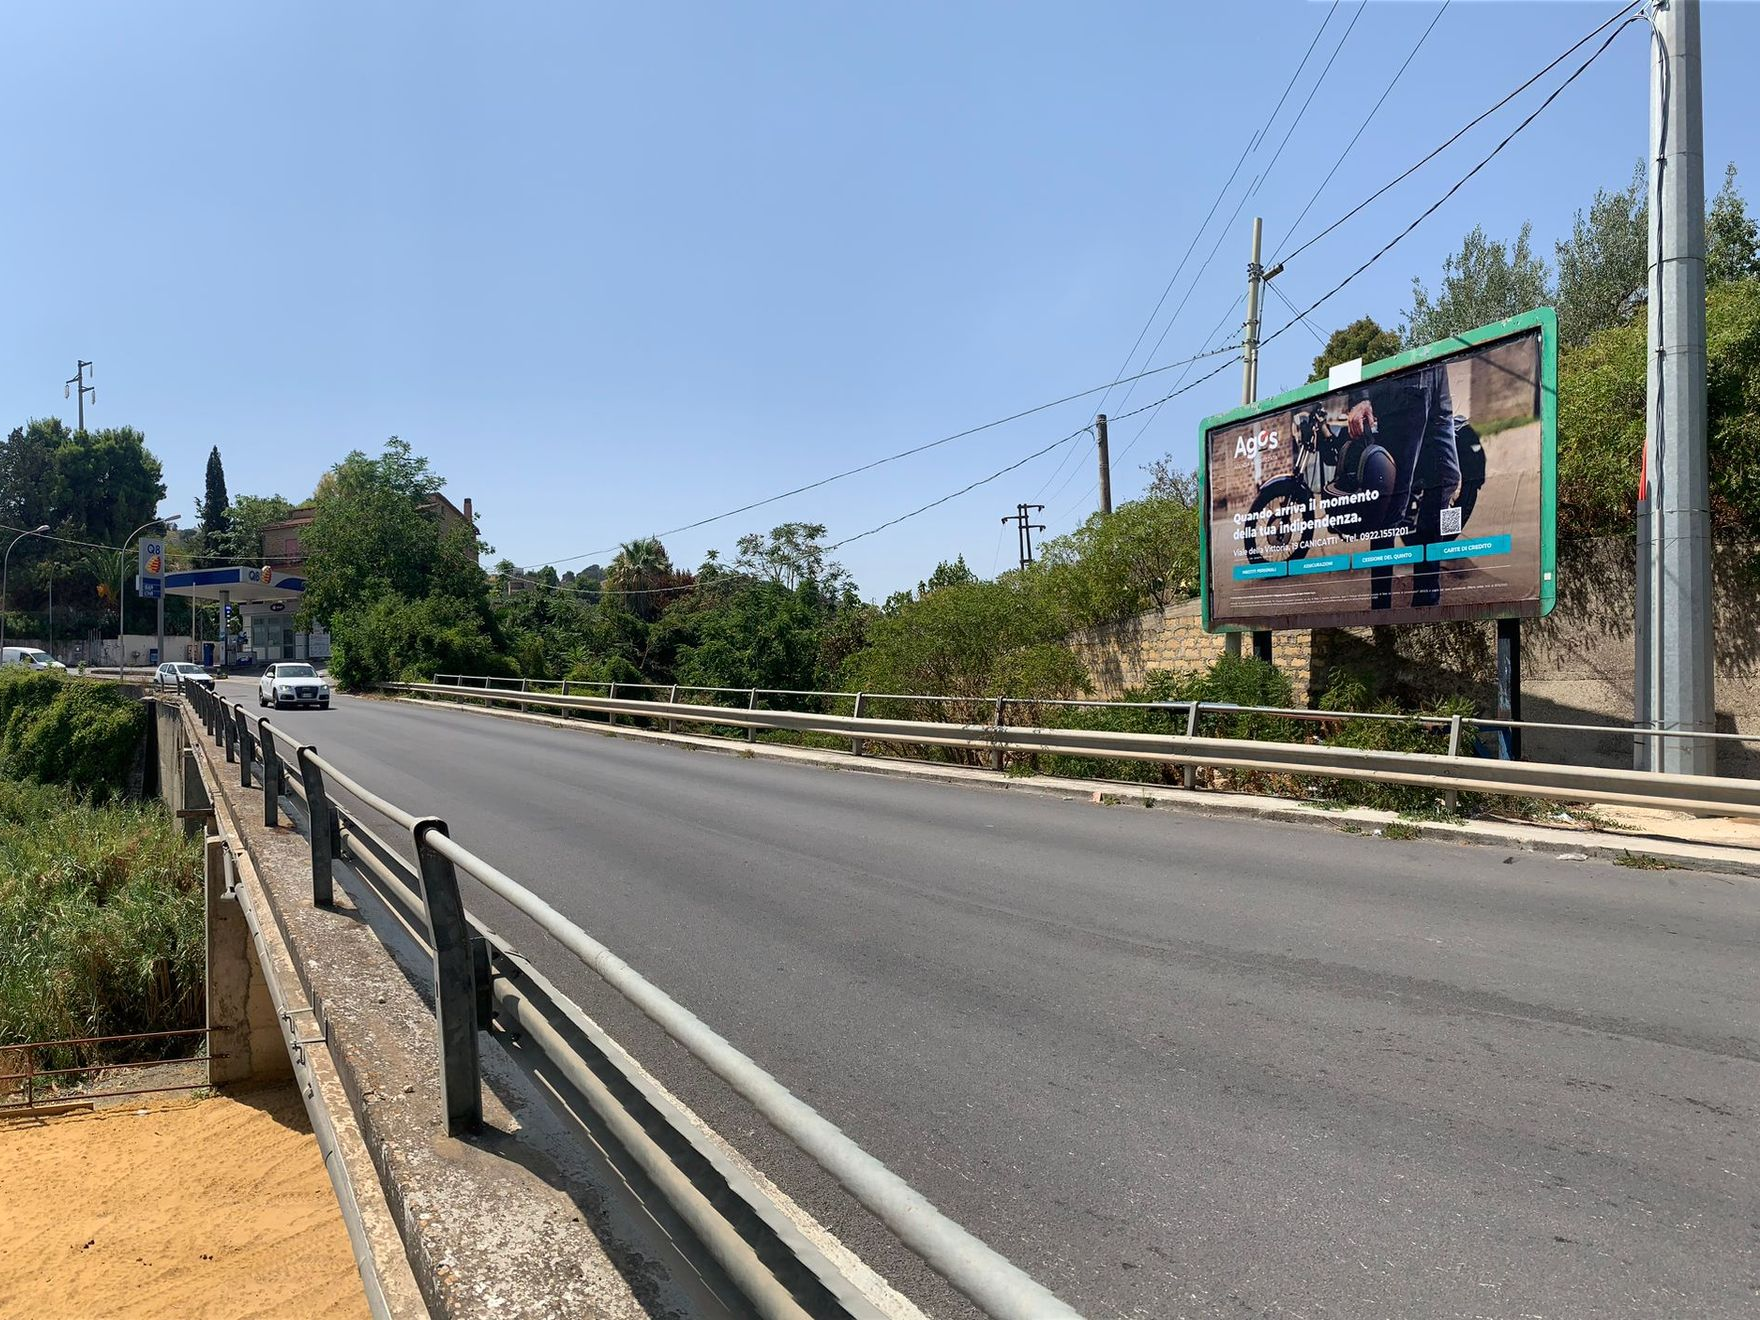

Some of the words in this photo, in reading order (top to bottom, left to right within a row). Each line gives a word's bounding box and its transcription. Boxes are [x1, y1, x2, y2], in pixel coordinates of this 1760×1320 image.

[1234, 430, 1279, 459] Agos
[1233, 507, 1273, 525] Quando
[1275, 501, 1306, 517] arriva
[1309, 498, 1315, 511] il
[1319, 489, 1379, 509] momento
[1233, 526, 1257, 540] della
[1259, 525, 1277, 536] tua
[1279, 512, 1362, 534] indipendenza.
[147, 543, 161, 555] Q8
[1233, 547, 1247, 556] Viale
[1248, 546, 1264, 555] della
[1292, 542, 1298, 550] 19
[1346, 533, 1358, 543] Tel.
[1360, 526, 1409, 541] 0922.1551201
[1443, 546, 1461, 554] CARTE
[1468, 542, 1493, 551] CREDITO
[1362, 555, 1383, 563] CESSIONE
[1393, 552, 1413, 560] QUINTO
[249, 570, 260, 582] Q8
